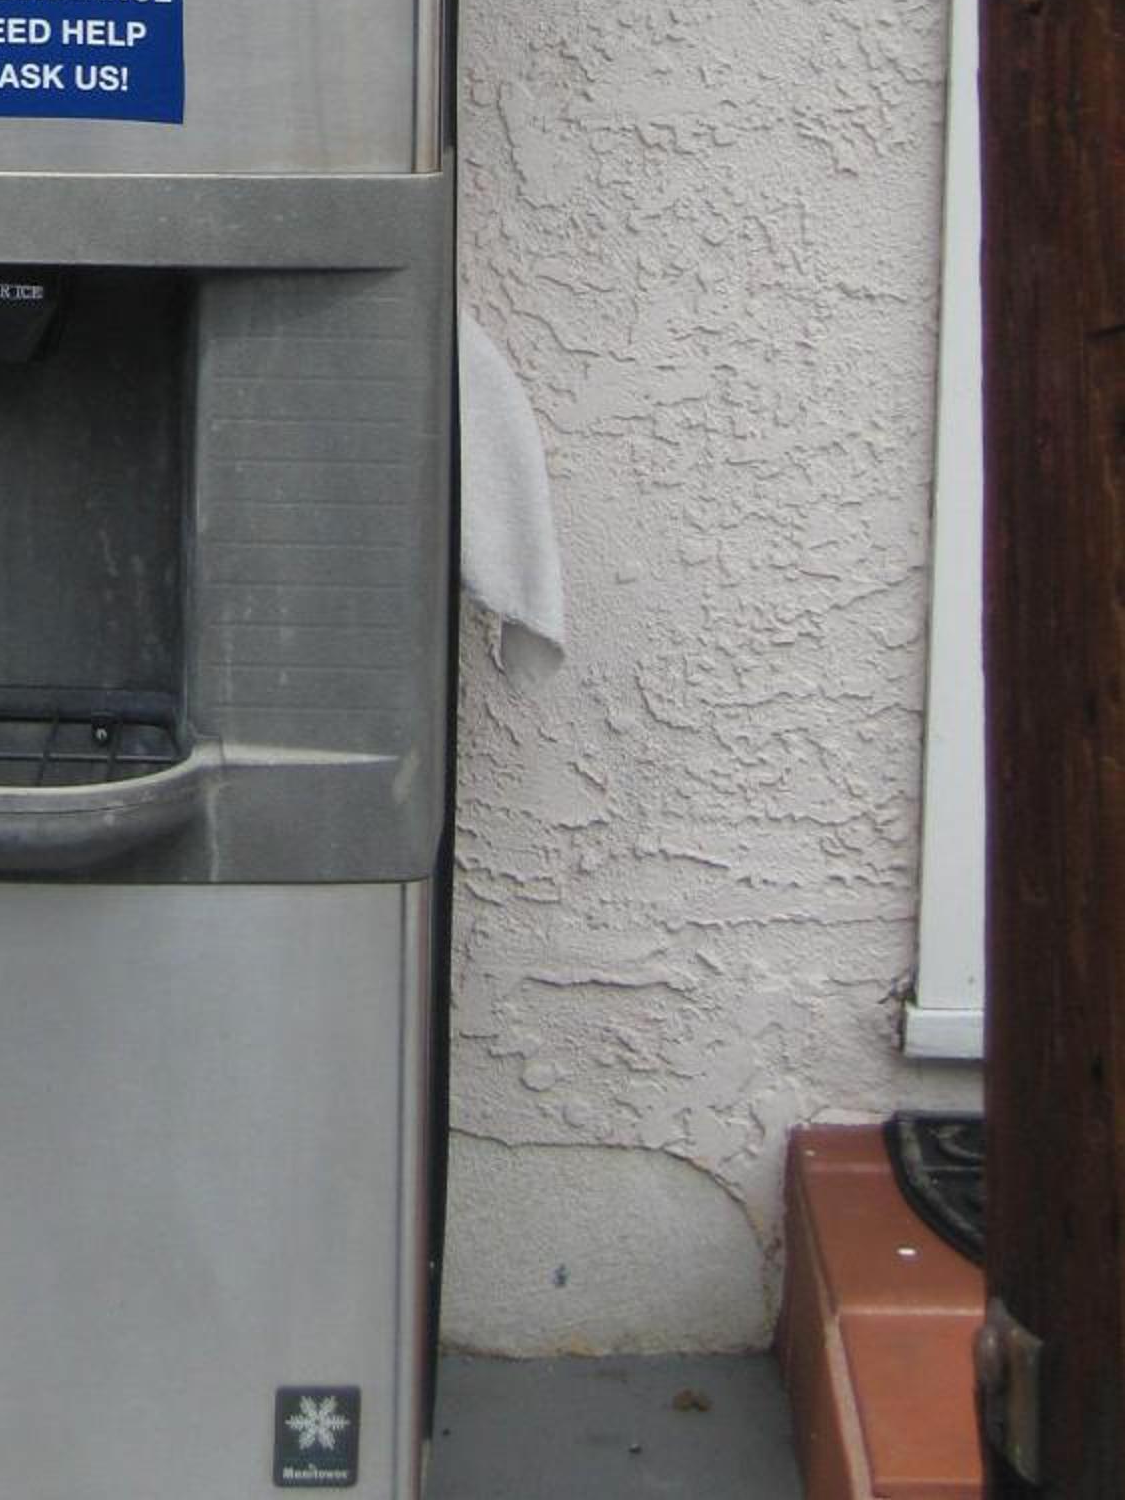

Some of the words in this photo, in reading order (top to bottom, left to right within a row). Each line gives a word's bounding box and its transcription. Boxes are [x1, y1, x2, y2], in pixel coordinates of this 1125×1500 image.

[62, 20, 148, 47] HELP
[74, 66, 129, 92] US!
[16, 285, 44, 299] ICE
